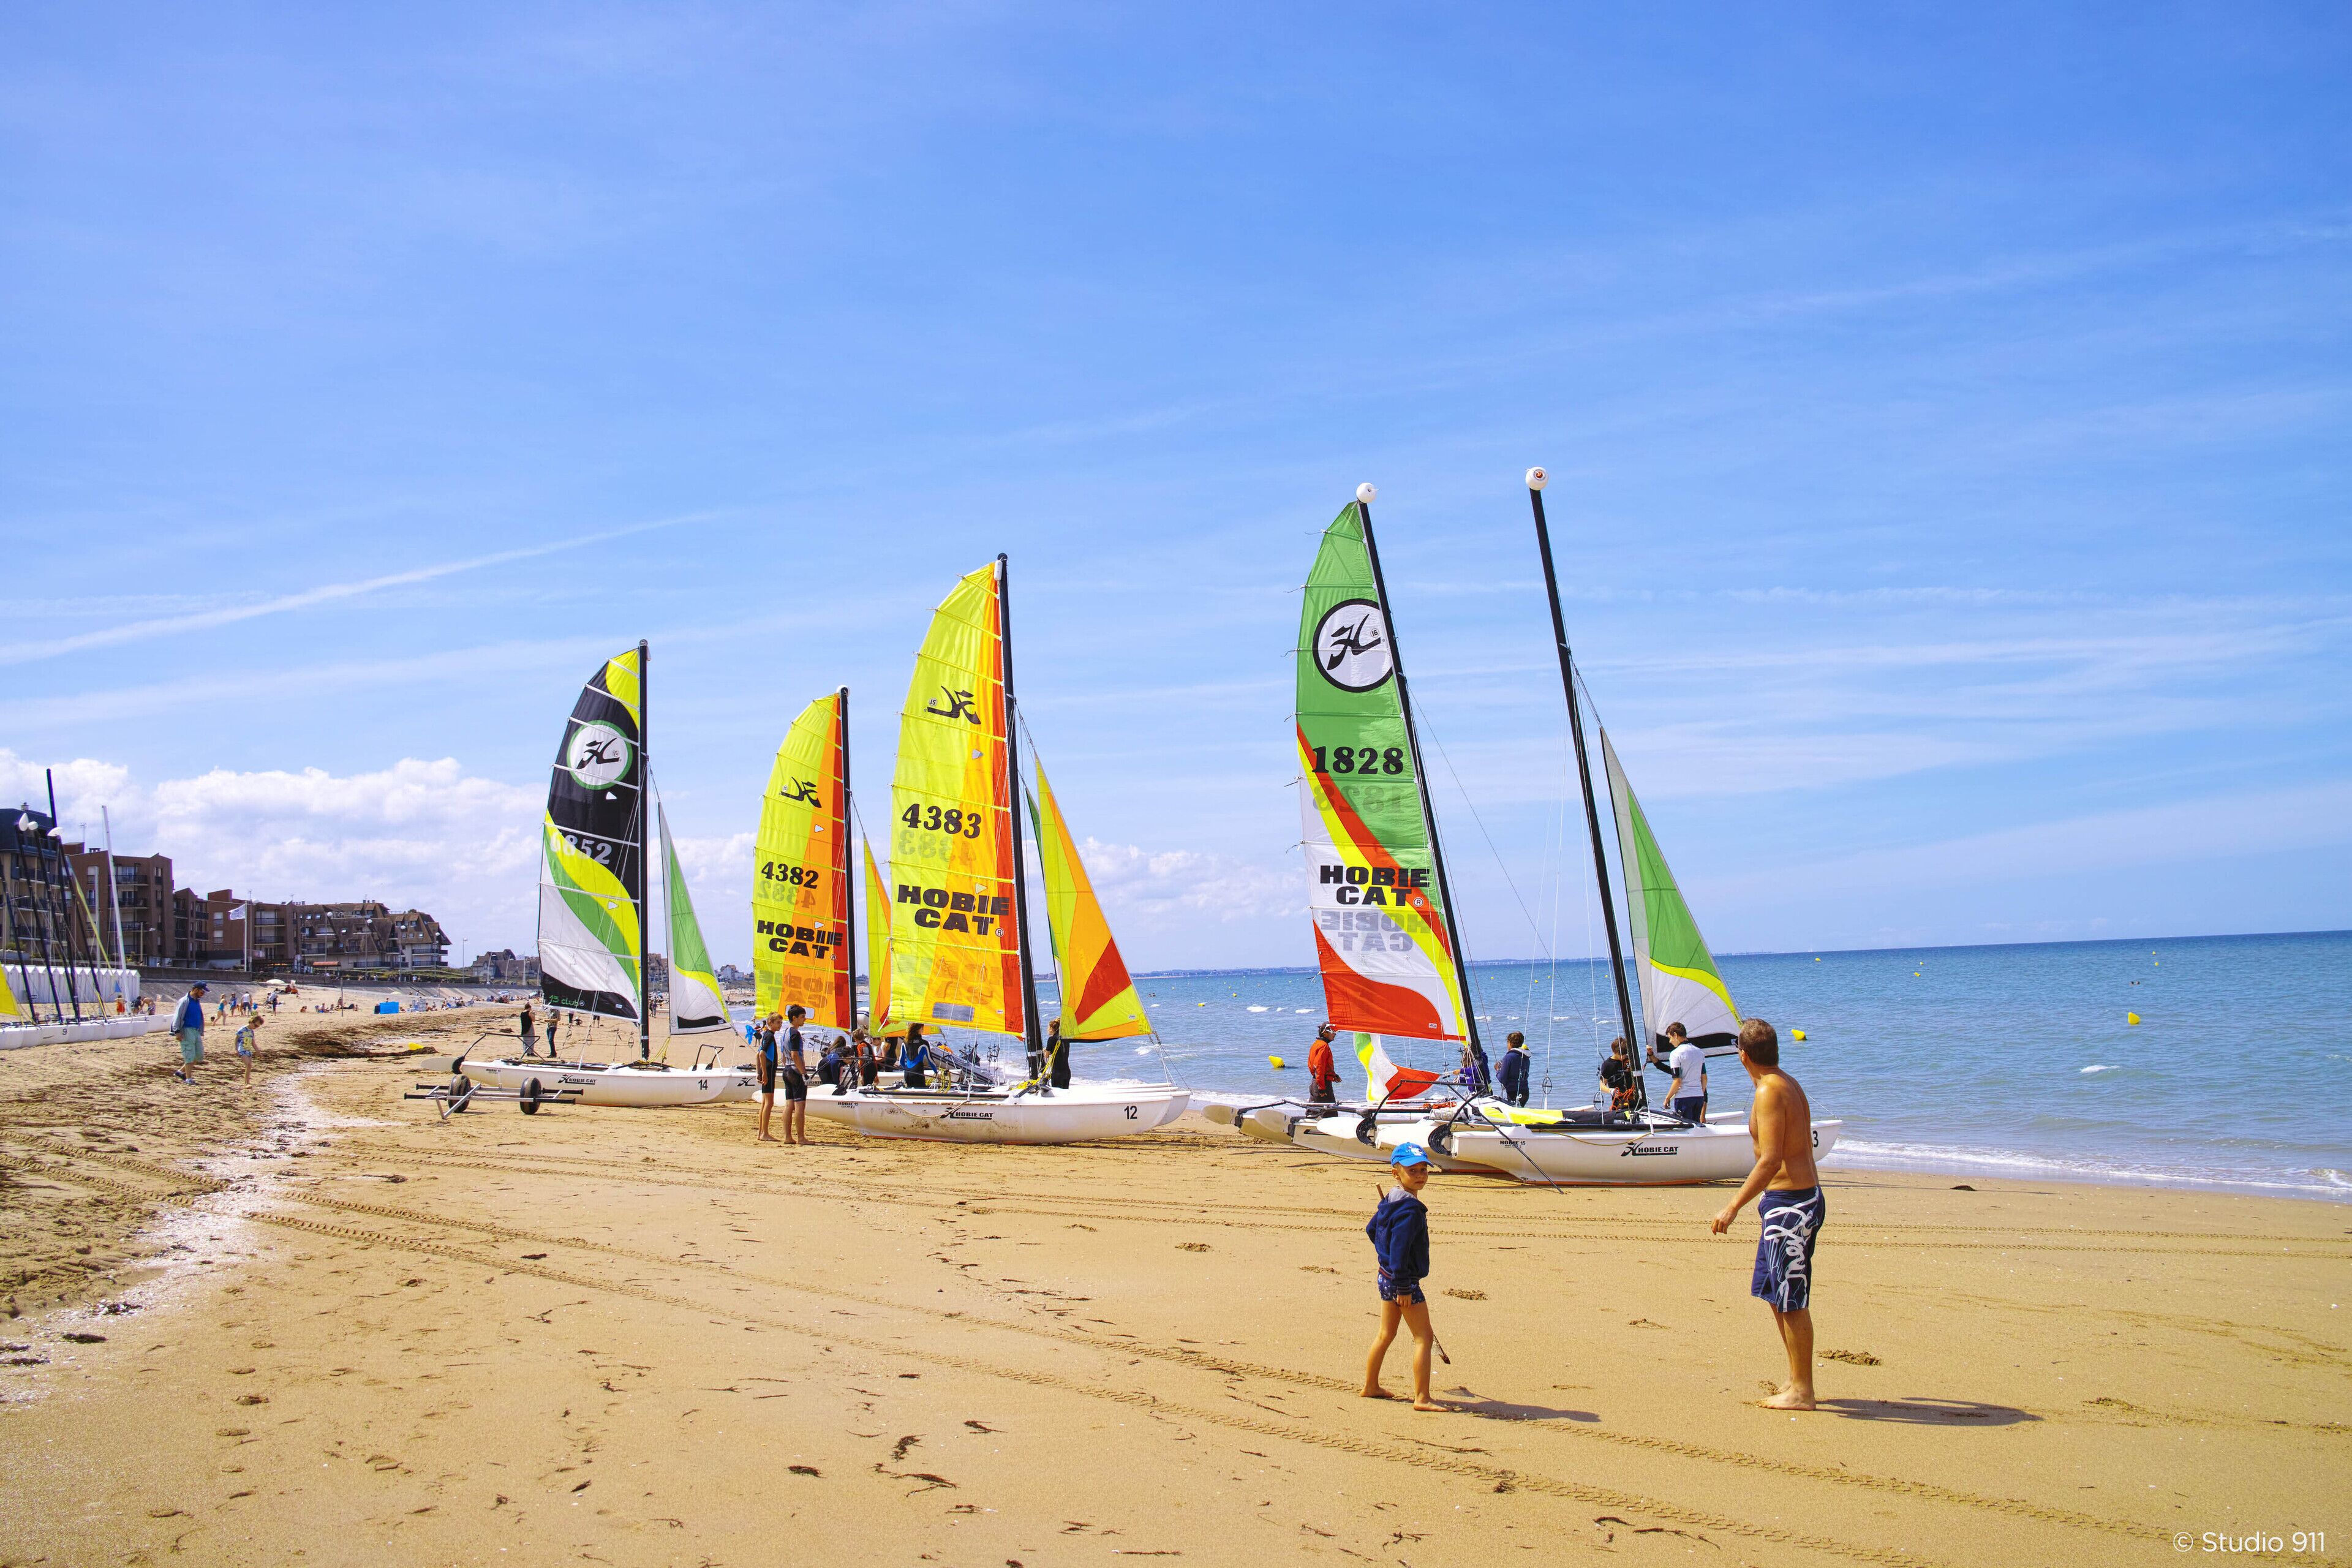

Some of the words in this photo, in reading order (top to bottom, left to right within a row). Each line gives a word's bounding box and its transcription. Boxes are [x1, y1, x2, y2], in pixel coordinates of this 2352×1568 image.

[1311, 745, 1404, 775] 1828
[902, 803, 982, 839] 4383
[761, 861, 819, 889] 4382
[1320, 865, 1430, 888] HOBIE
[897, 884, 1010, 916] HOBIE
[1336, 886, 1412, 906] CAT
[756, 919, 843, 946] HOBIE
[914, 908, 994, 936] CAT
[769, 938, 829, 959] CAT
[561, 998, 579, 1006] club
[698, 1079, 708, 1090] 14
[1124, 1105, 1137, 1120] 12
